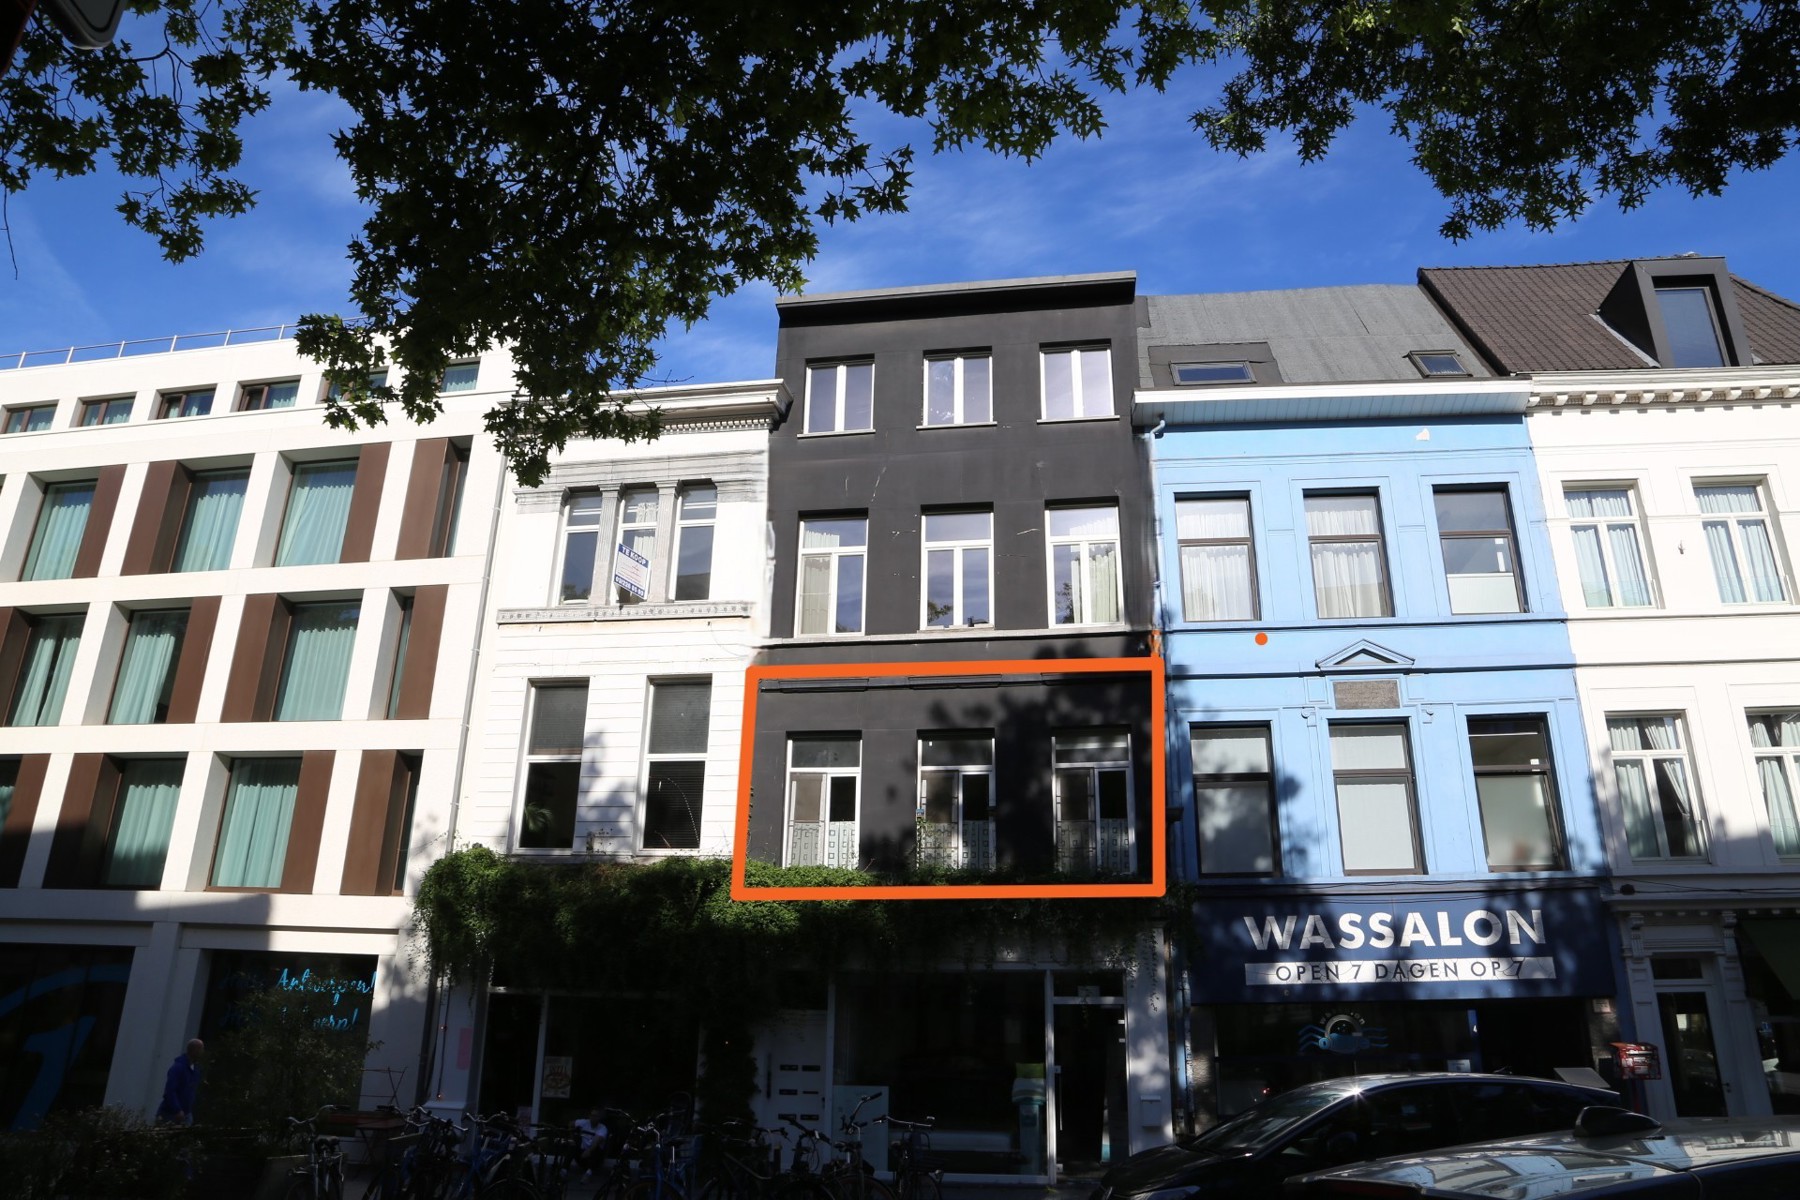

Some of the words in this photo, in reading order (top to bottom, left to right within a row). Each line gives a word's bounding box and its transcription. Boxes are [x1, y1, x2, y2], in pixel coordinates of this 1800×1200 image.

[1244, 909, 1546, 950] WASSALON
[1276, 963, 1340, 982] OPEN
[1352, 963, 1362, 980] 7
[1375, 961, 1459, 980] DAGEN
[1471, 961, 1501, 978] OP
[1513, 960, 1526, 977] 7
